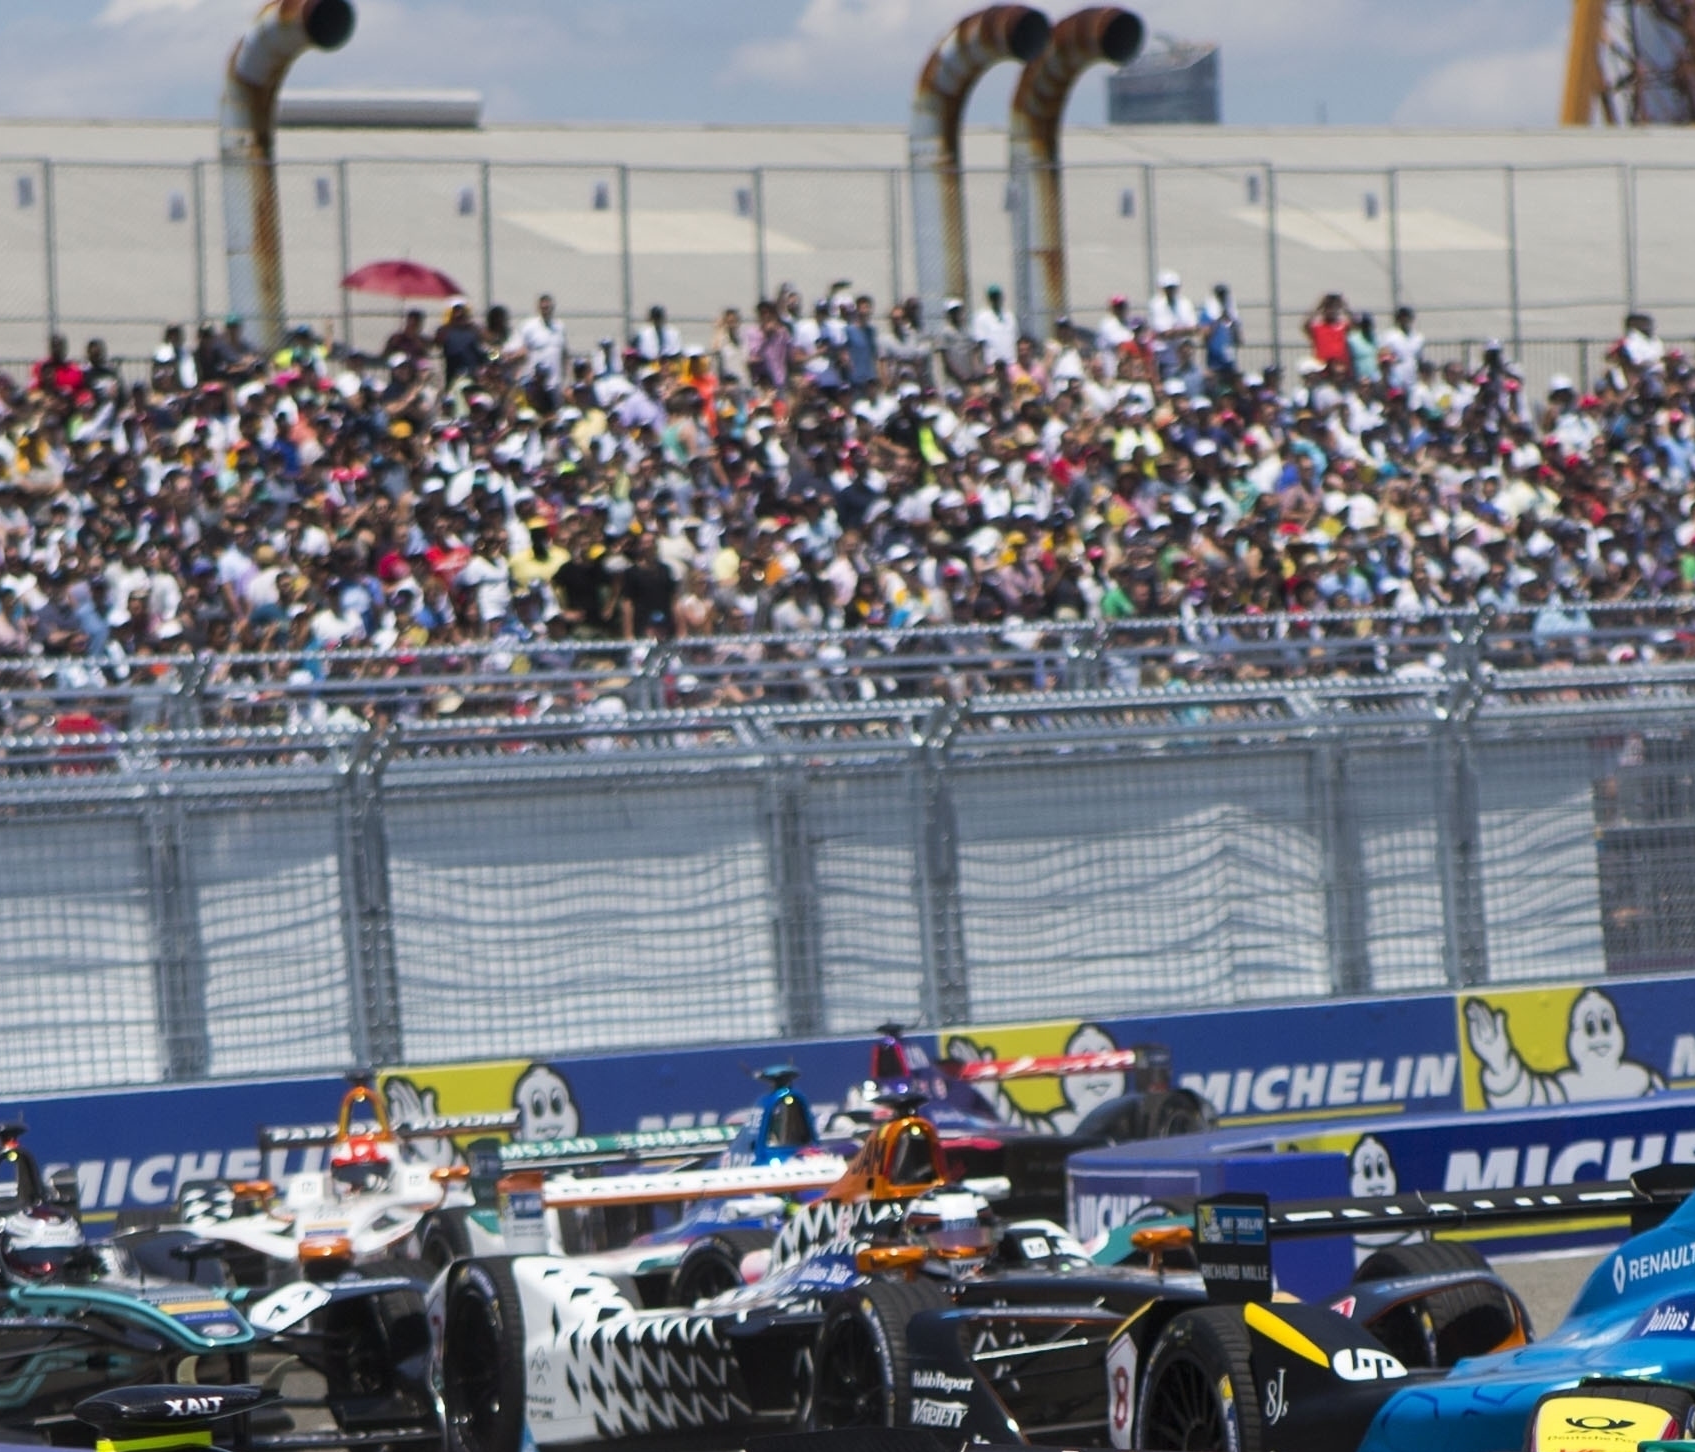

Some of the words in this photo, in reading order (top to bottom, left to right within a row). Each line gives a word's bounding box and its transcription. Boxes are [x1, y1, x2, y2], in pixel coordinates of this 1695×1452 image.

[1177, 1053, 1458, 1115] MICHELIN
[1200, 1263, 1240, 1281] RICHARD
[1241, 1264, 1269, 1282] MILLE
[1642, 1305, 1690, 1337] Julius
